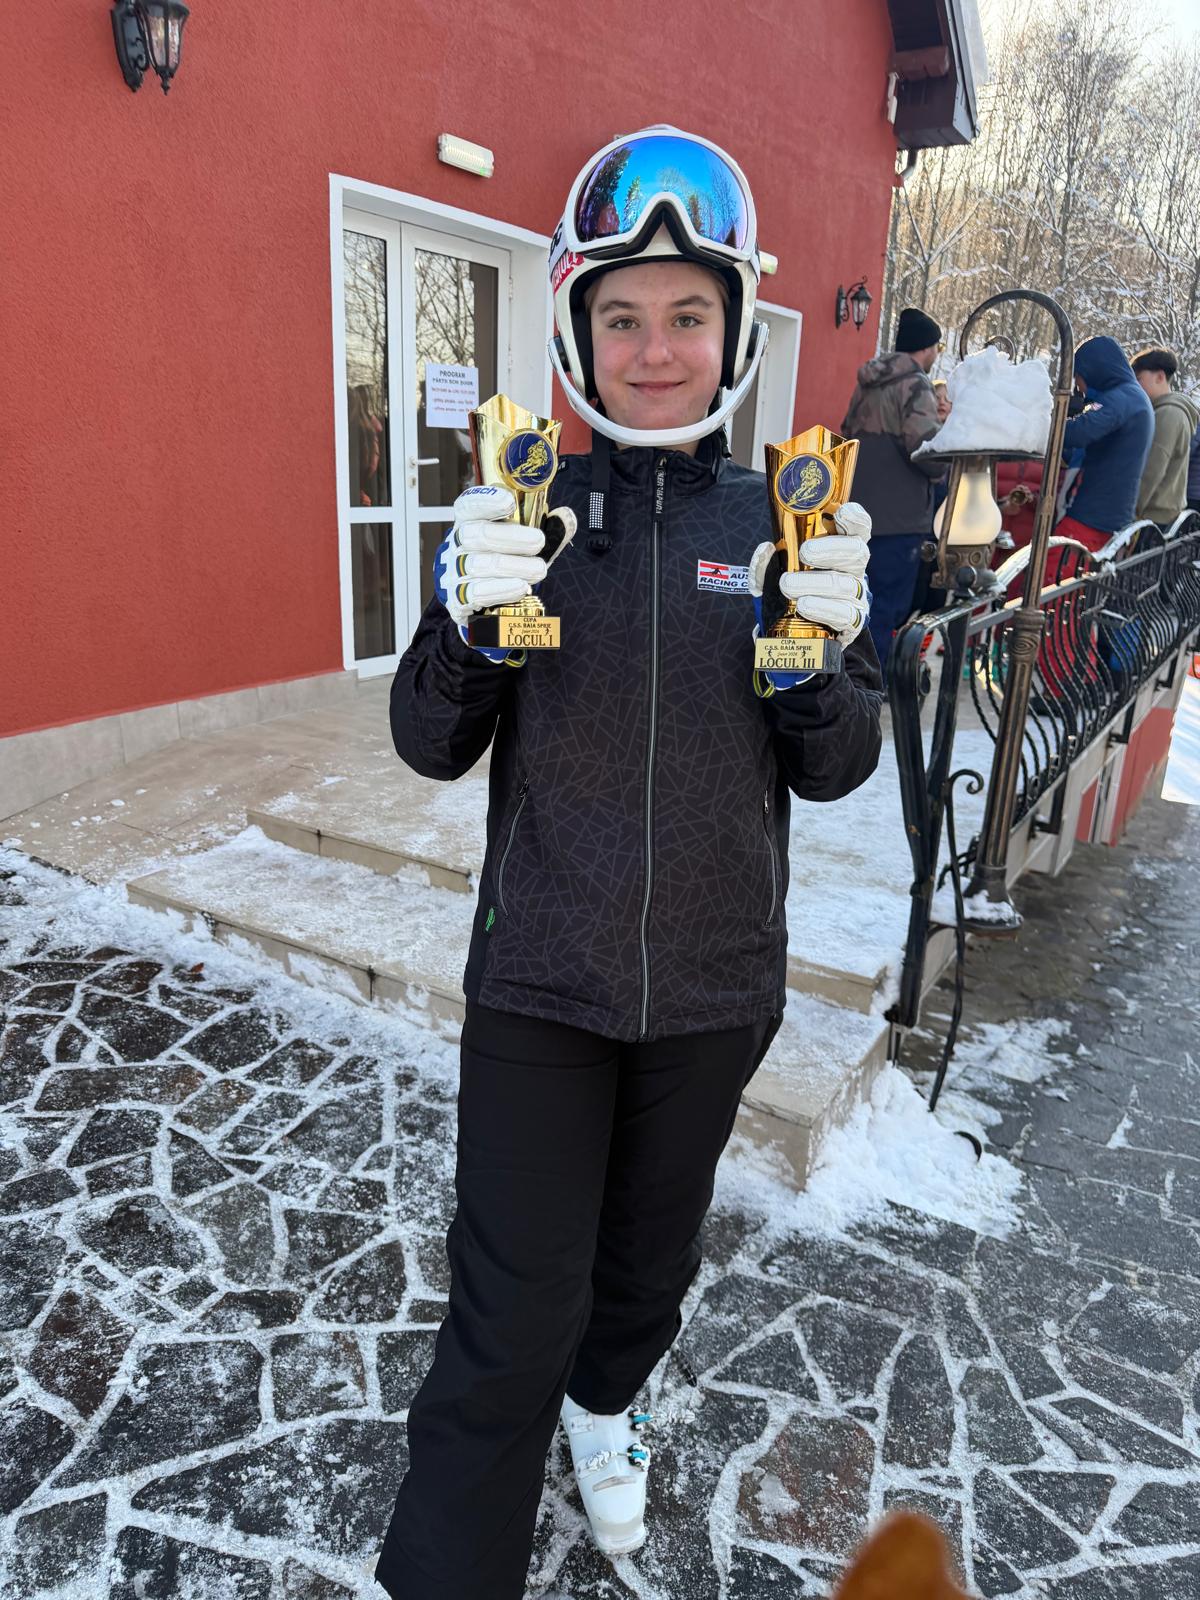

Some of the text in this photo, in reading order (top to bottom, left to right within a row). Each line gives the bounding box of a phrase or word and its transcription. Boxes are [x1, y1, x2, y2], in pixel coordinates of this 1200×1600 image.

[439, 370, 465, 378] PROGRAM
[699, 577, 738, 587] RACING
[507, 634, 546, 647] LOCUL
[760, 657, 816, 668] LOCUL III
